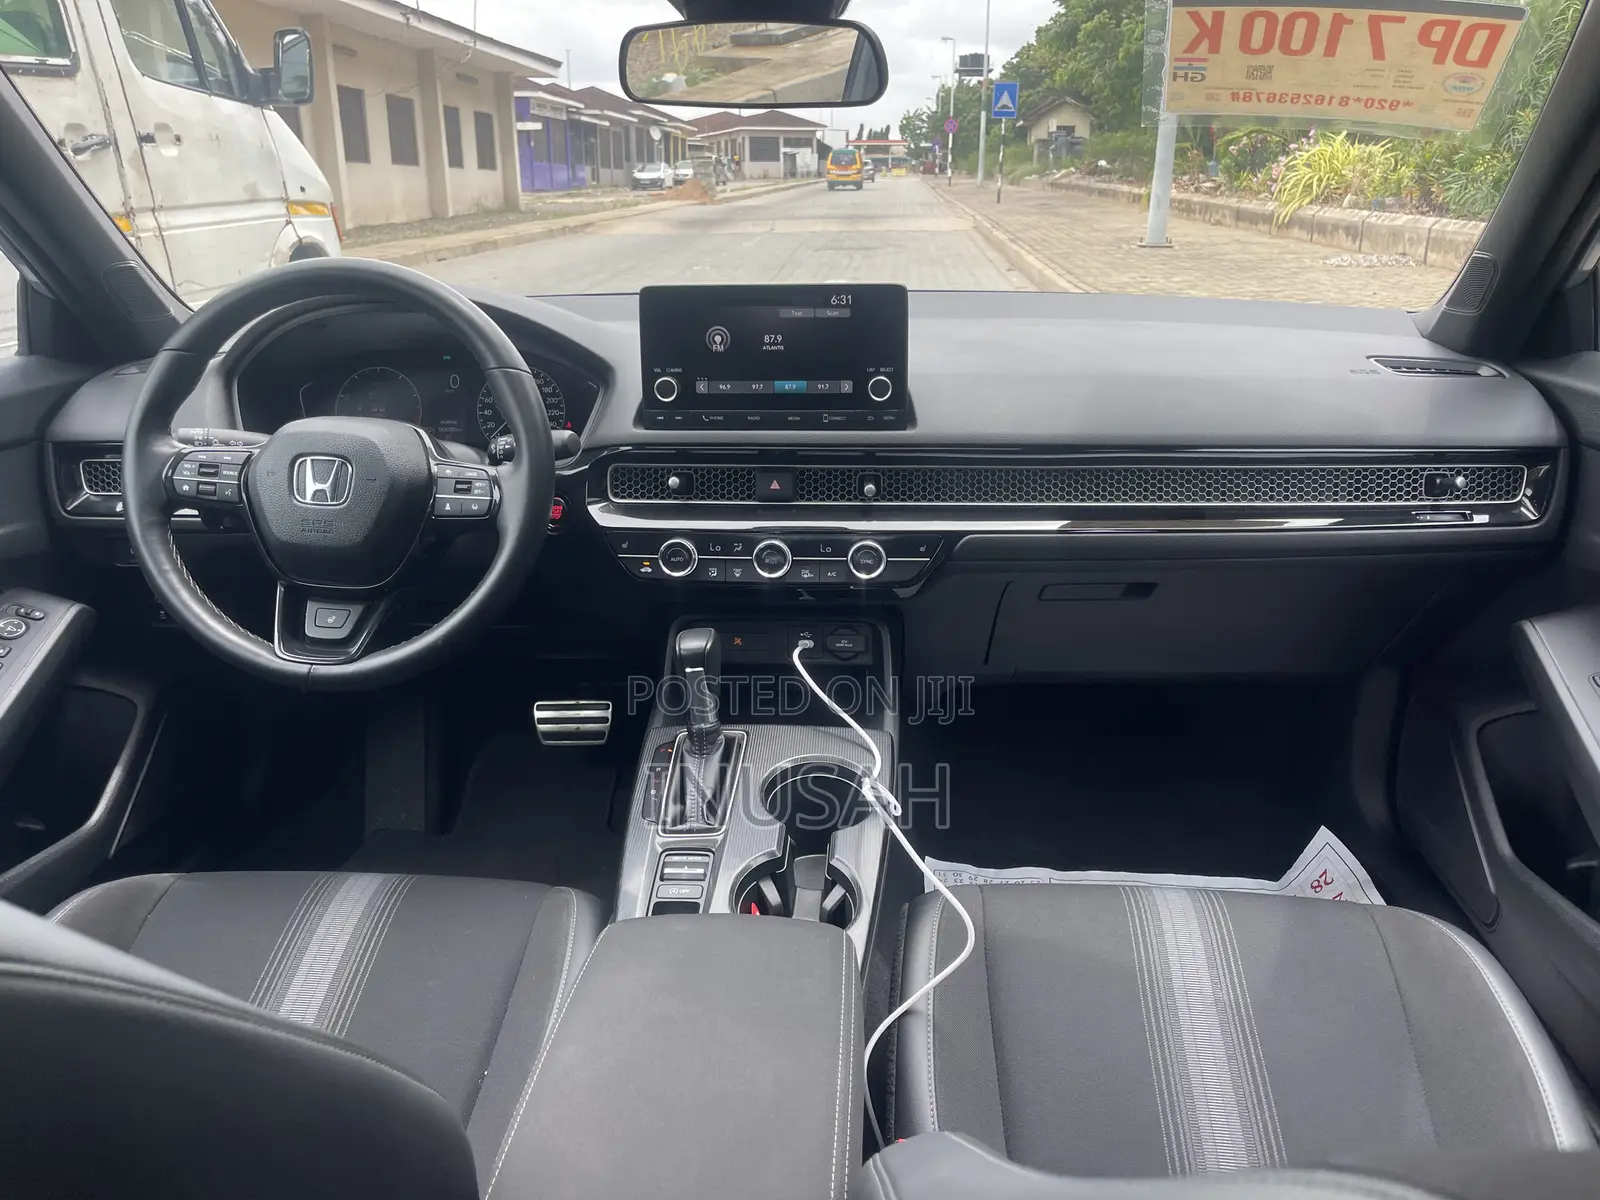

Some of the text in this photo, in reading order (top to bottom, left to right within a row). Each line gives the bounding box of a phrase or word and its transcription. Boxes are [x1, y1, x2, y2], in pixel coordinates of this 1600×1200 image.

[830, 294, 853, 306] 6:31
[763, 334, 783, 344] 87.9
[712, 344, 725, 353] FM
[449, 374, 460, 389] 0
[709, 543, 722, 552] Lo
[820, 544, 832, 553] Lo
[1310, 868, 1335, 894] 28
